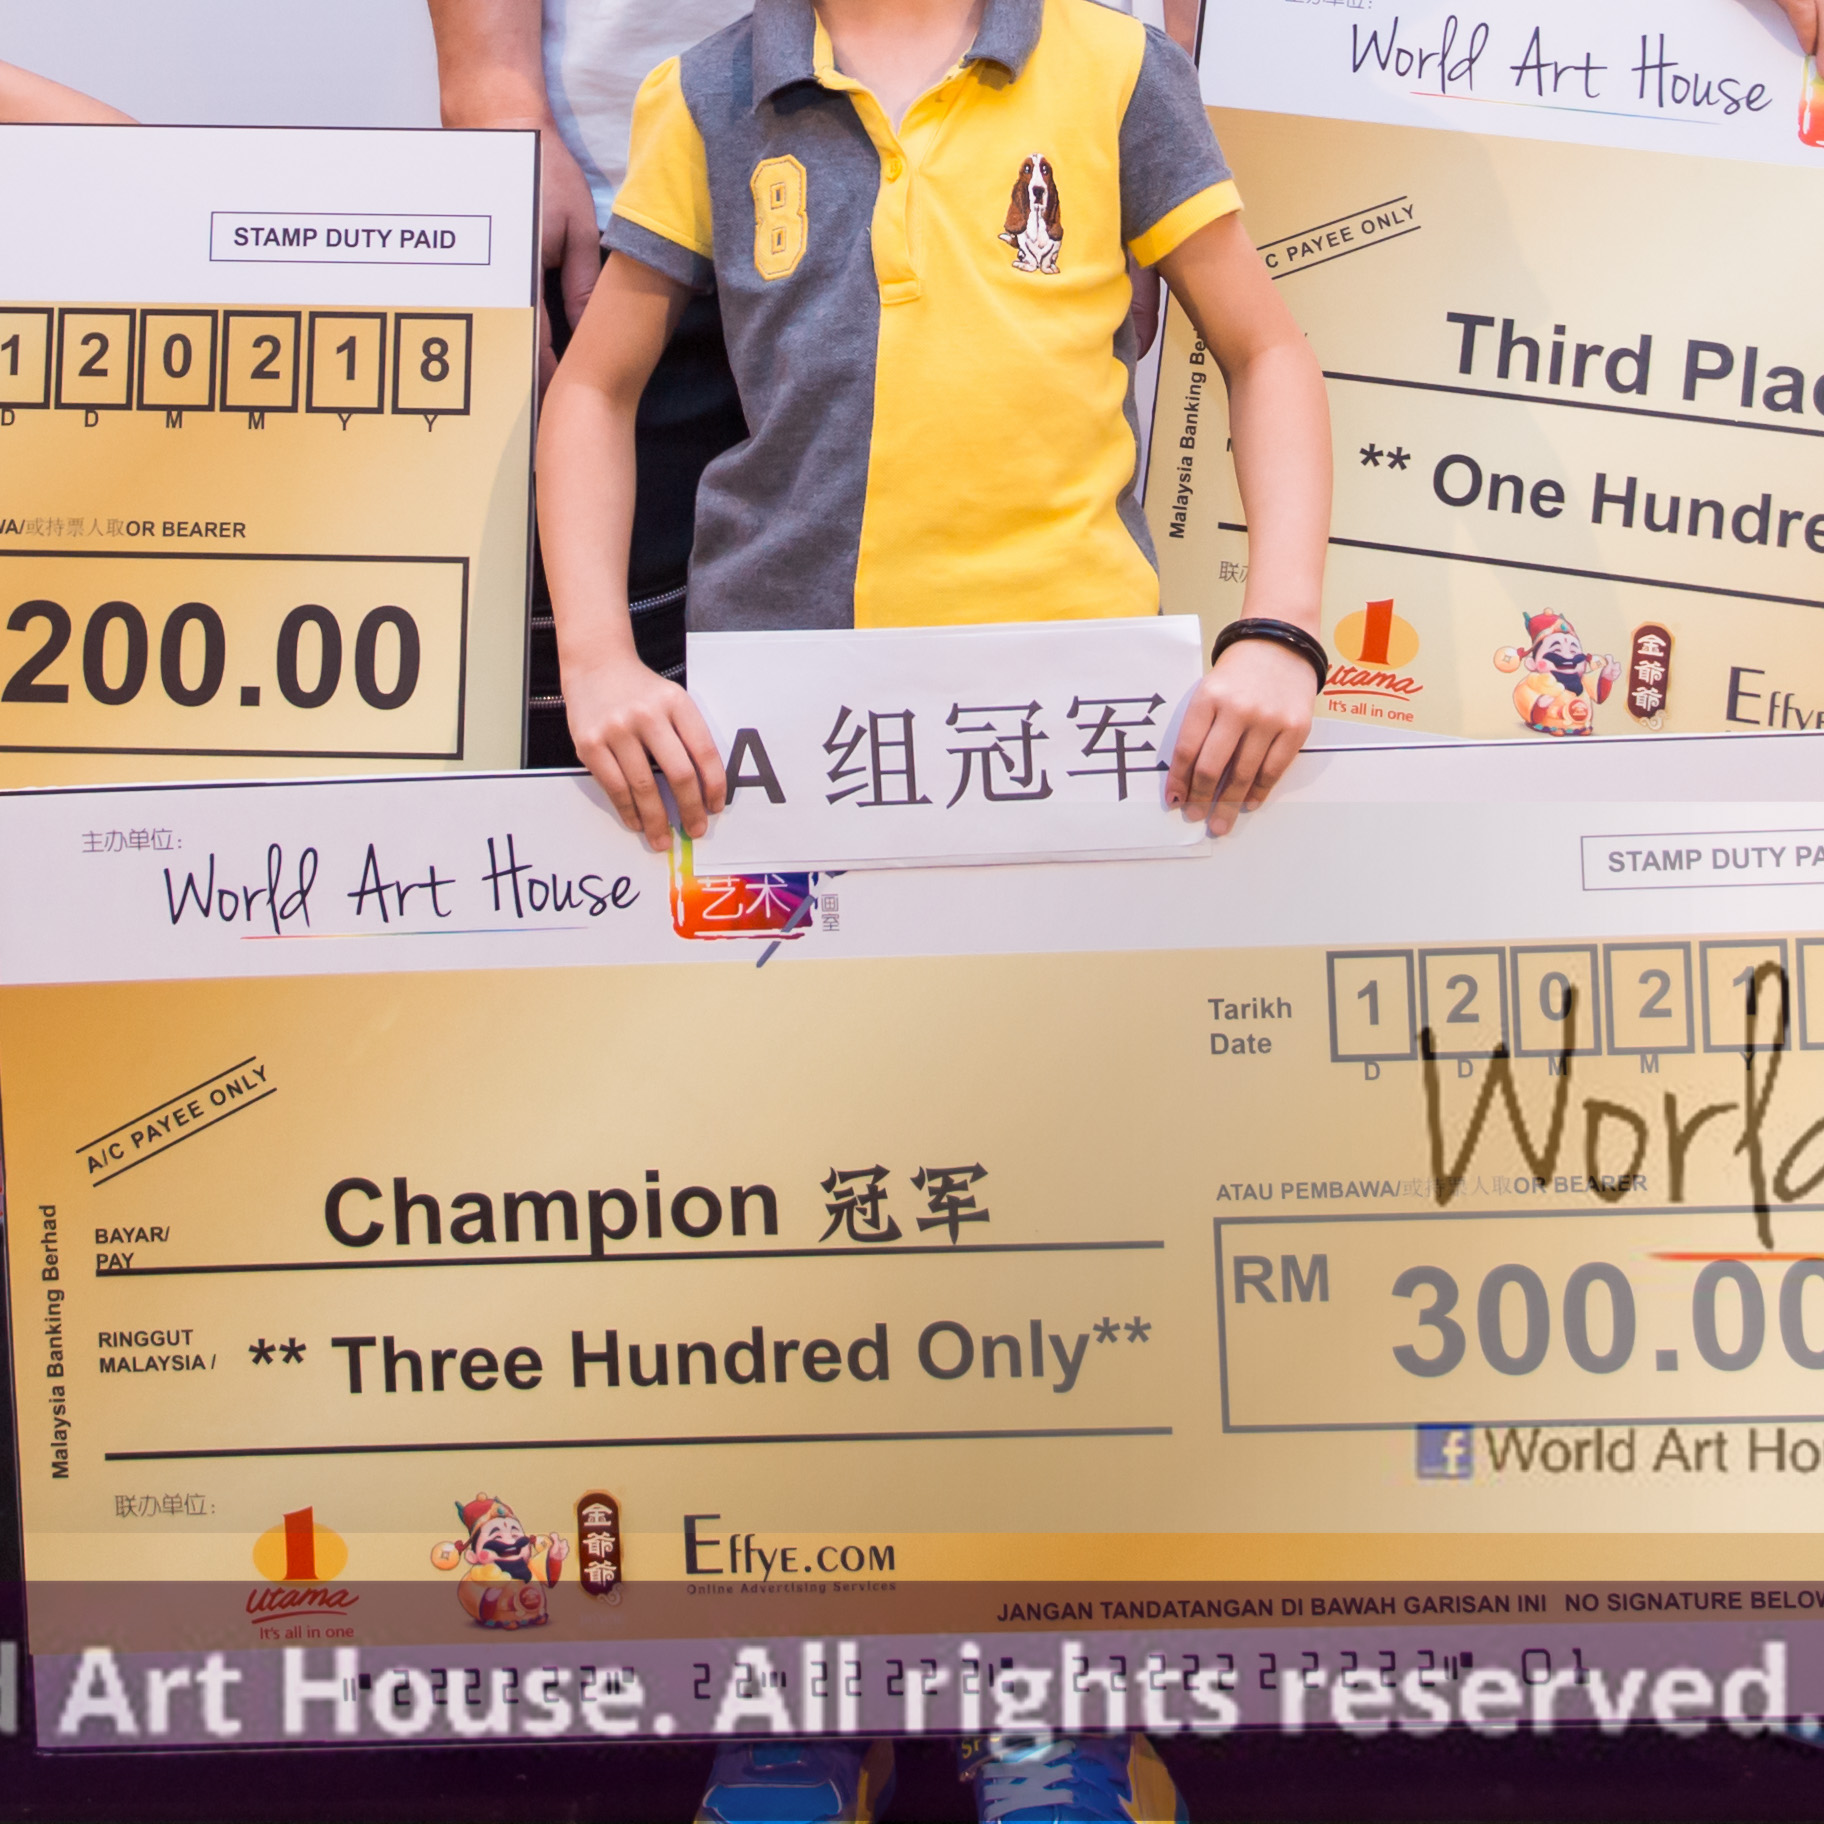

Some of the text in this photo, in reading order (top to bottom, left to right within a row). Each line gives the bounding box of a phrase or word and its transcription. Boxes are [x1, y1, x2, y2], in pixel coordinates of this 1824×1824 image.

[1351, 14, 1772, 115] World Art House
[233, 227, 457, 249] STAMP DUTY PAID
[1286, 227, 1354, 261] PAYEE
[1361, 204, 1414, 234] ONLY
[1446, 310, 1652, 395] Third
[1180, 374, 1207, 449] Banking
[1169, 456, 1193, 539] Malaysia
[1432, 452, 1566, 520] One
[161, 520, 247, 539] BEARER
[1, 599, 421, 710] 200.00
[724, 728, 787, 805] A
[822, 693, 1172, 811] 组冠军
[163, 832, 640, 936] World Art House
[1607, 847, 1702, 873] STAMP
[1710, 846, 1787, 872] DUTY
[697, 873, 791, 921] 艺术
[1208, 997, 1293, 1021] Tarikh
[1209, 1032, 1272, 1056] Date
[85, 1064, 270, 1173] A/C PAYEE ONLY
[324, 1169, 778, 1257] Champion
[818, 1162, 990, 1245] 冠军
[1216, 1182, 1272, 1201] ATAU
[95, 1226, 171, 1246] BAYAR/
[1232, 1254, 1330, 1303] RM
[41, 1203, 70, 1479] Malaysia Banking Berhad
[98, 1329, 194, 1348] RINGGUT
[99, 1352, 205, 1374] MALAYSIA
[331, 1335, 543, 1394] Three
[572, 1321, 889, 1388] Hundred
[997, 1599, 1093, 1622] JANGAN
[1099, 1596, 1274, 1620] TANDATANGAN
[1281, 1596, 1303, 1617] DI
[1311, 1596, 1396, 1615] BAWAH
[1403, 1594, 1511, 1616] GARISAN
[1517, 1593, 1547, 1613] INI
[1566, 1591, 1599, 1612] NO
[1607, 1590, 1743, 1612] SIGNATURE
